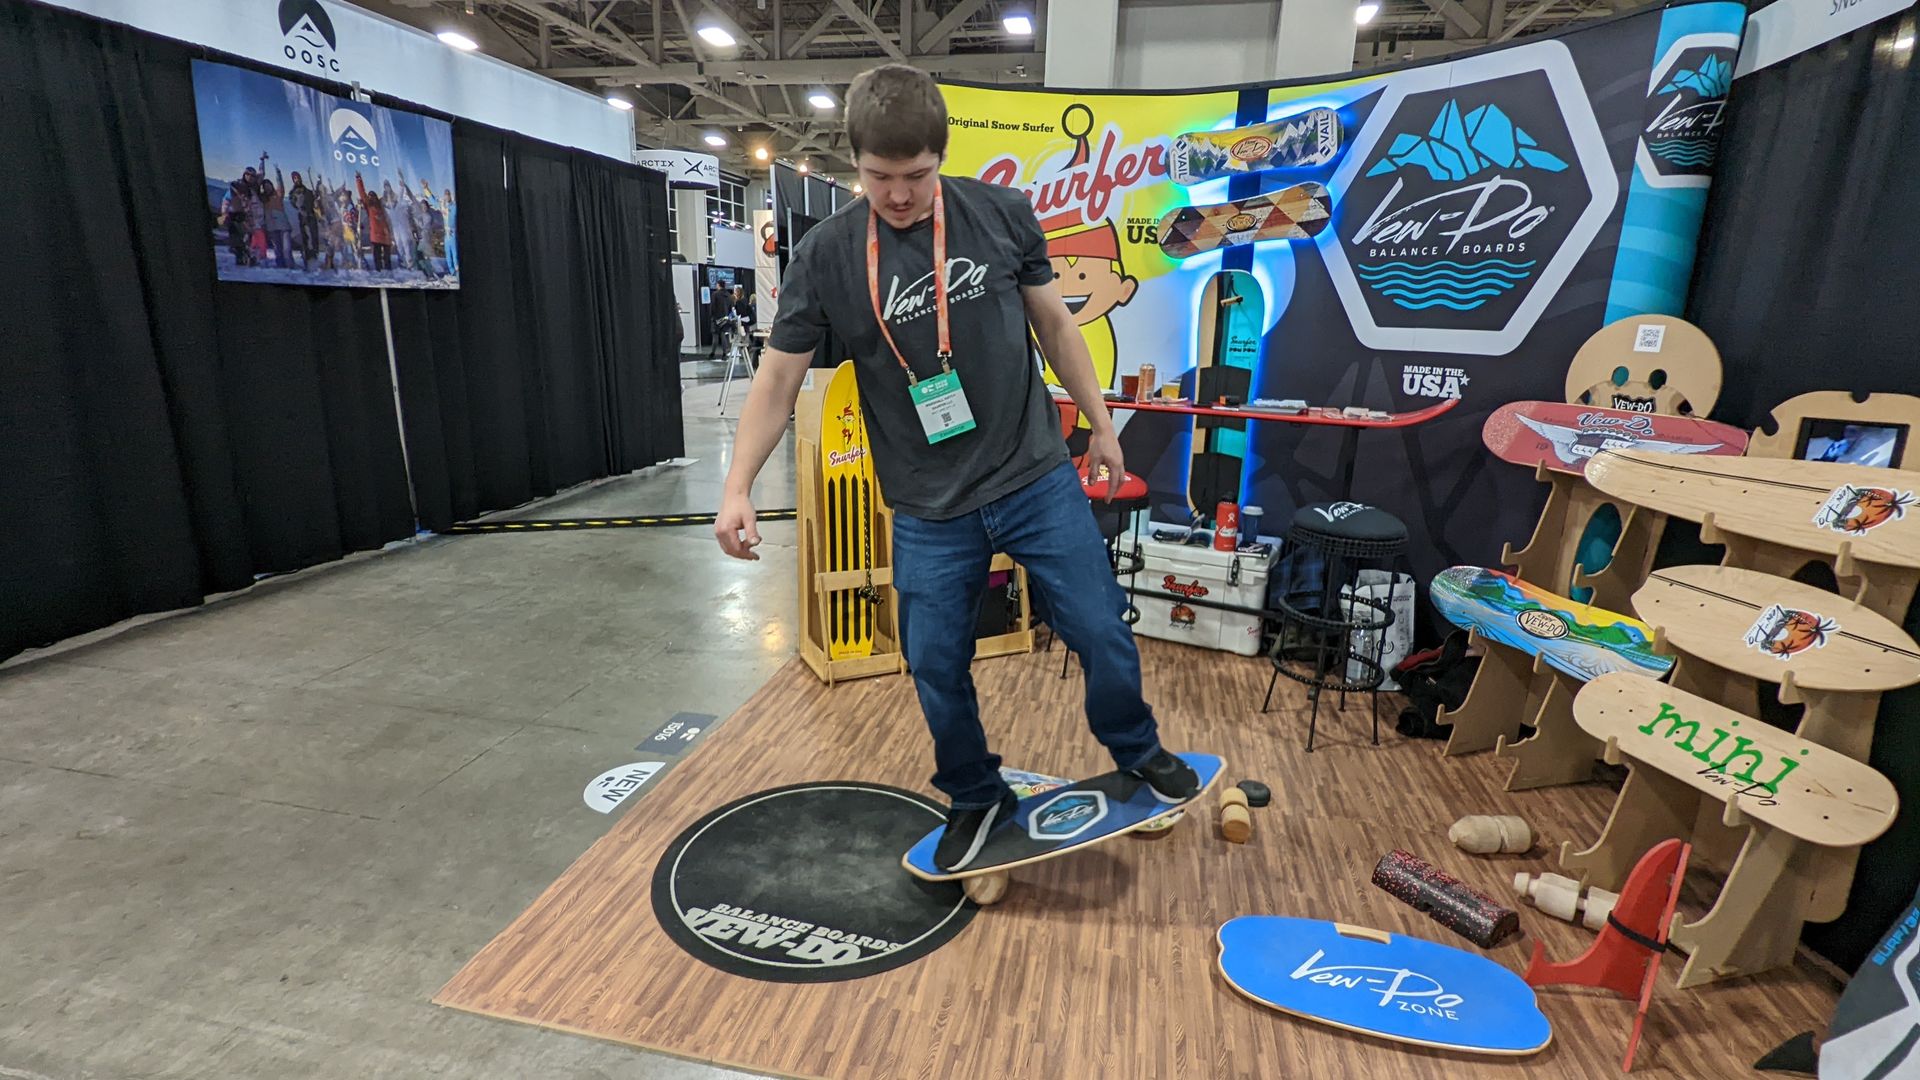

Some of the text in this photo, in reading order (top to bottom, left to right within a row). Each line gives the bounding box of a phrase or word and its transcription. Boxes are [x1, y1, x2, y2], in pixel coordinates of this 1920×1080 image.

[284, 44, 340, 72] OOSC
[947, 116, 1055, 133] Original Snow Surfer
[1320, 113, 1330, 147] VAIL
[333, 150, 380, 167] OOSC
[636, 160, 676, 168] ARCTIX
[1177, 151, 1189, 180] VAIL
[980, 129, 1167, 222] urfer
[1126, 217, 1152, 225] MADE
[1352, 174, 1550, 255] Vew-Do
[1369, 242, 1527, 258] BALANCE BOARDS
[882, 257, 988, 321] Vew-Do
[896, 284, 985, 325] BALANCE BOARDS
[1403, 364, 1465, 377] MADE IN THE
[1402, 373, 1462, 400] USA
[1614, 397, 1653, 414] VEW-DO
[1577, 412, 1655, 437] Vew-Do
[1524, 611, 1564, 636] VEW-DO
[1637, 702, 1810, 794] mini
[601, 769, 651, 803] NEW
[1695, 763, 1779, 806] Vew-Do
[684, 907, 862, 964] VEW-DO
[711, 903, 902, 952] BALANCE BOARDS
[1289, 949, 1465, 1008] Vew-Do
[1396, 1000, 1460, 1021] ZONE
